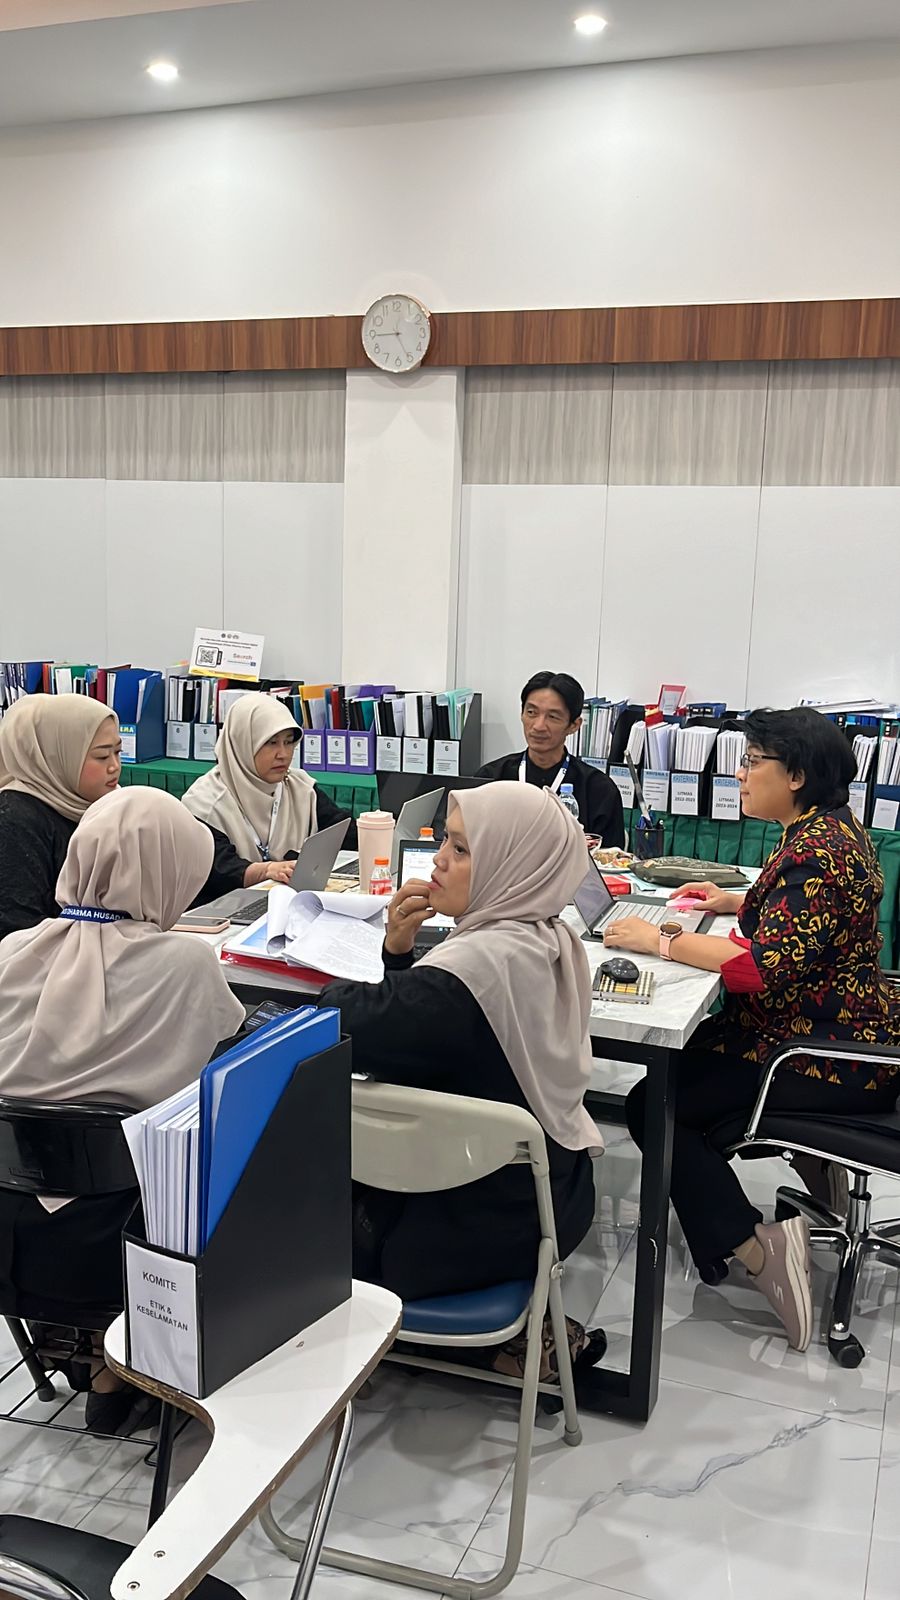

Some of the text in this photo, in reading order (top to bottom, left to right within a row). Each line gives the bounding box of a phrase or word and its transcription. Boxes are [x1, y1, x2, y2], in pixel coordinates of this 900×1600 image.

[382, 305, 388, 316] 11
[392, 301, 402, 312] 12
[372, 316, 382, 326] 10
[415, 314, 422, 325] 2
[369, 330, 376, 340] 9
[420, 328, 426, 338] 3
[374, 344, 380, 354] 8
[416, 342, 422, 352] 4
[384, 352, 390, 363] 7
[394, 356, 402, 367] 6
[407, 352, 414, 362] 5
[142, 1271, 177, 1292] KOMITE
[150, 1300, 172, 1314] ETIK &
[136, 1304, 188, 1331] KESELAMATAN
